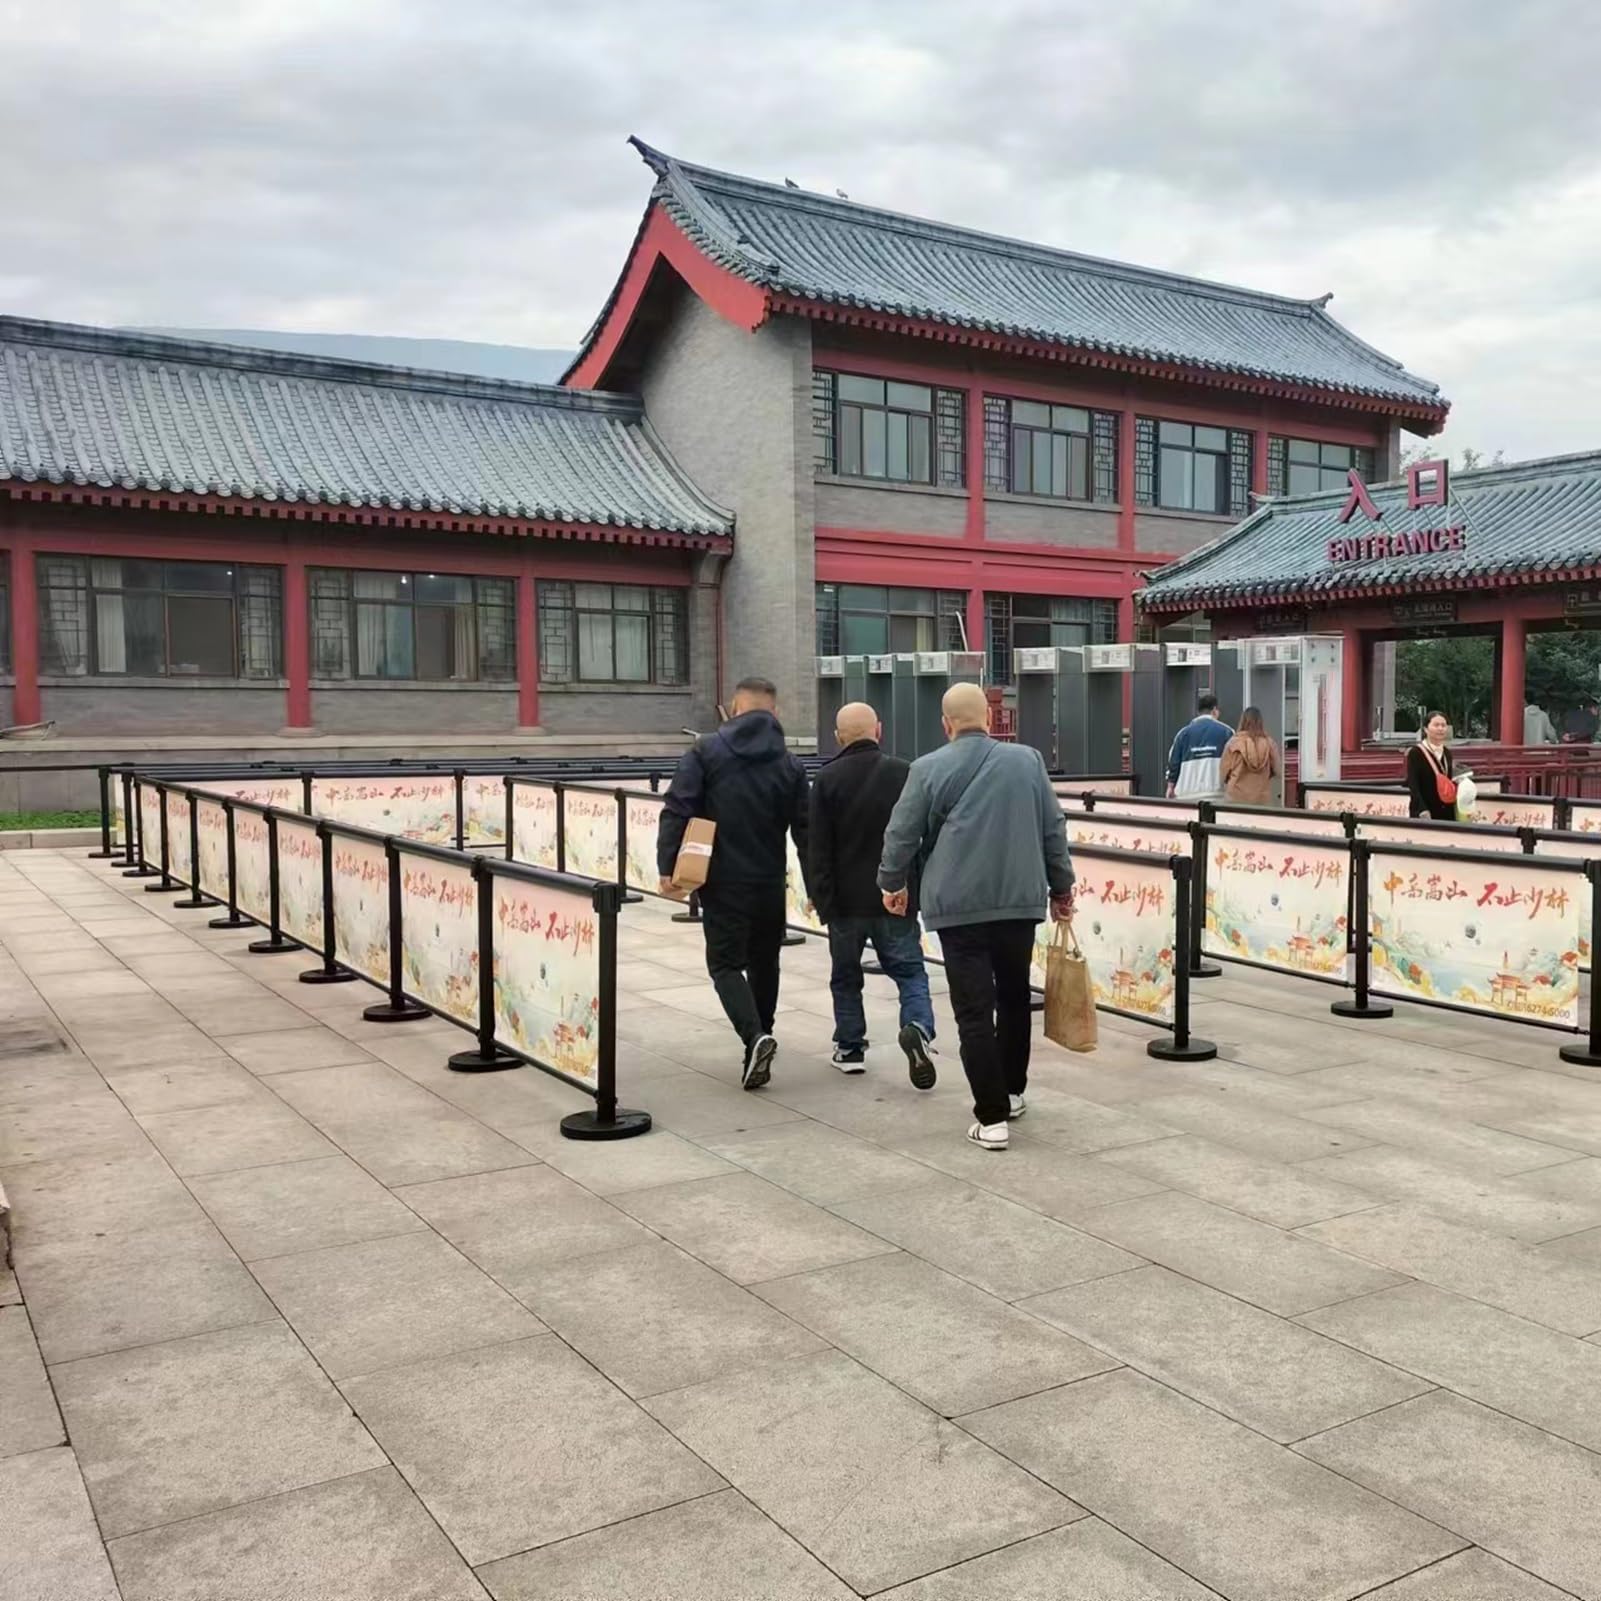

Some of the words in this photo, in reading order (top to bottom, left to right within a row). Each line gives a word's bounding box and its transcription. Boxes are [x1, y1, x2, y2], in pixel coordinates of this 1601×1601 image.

[1338, 459, 1448, 523] 入口
[1327, 525, 1466, 562] ENTRANCE
[1215, 847, 1273, 880] 中岳嵩山
[1279, 856, 1344, 889] 不止少林
[1100, 880, 1164, 917] 不止少林
[1383, 871, 1468, 906] 中岳嵩山
[1477, 881, 1569, 920] 不止少林
